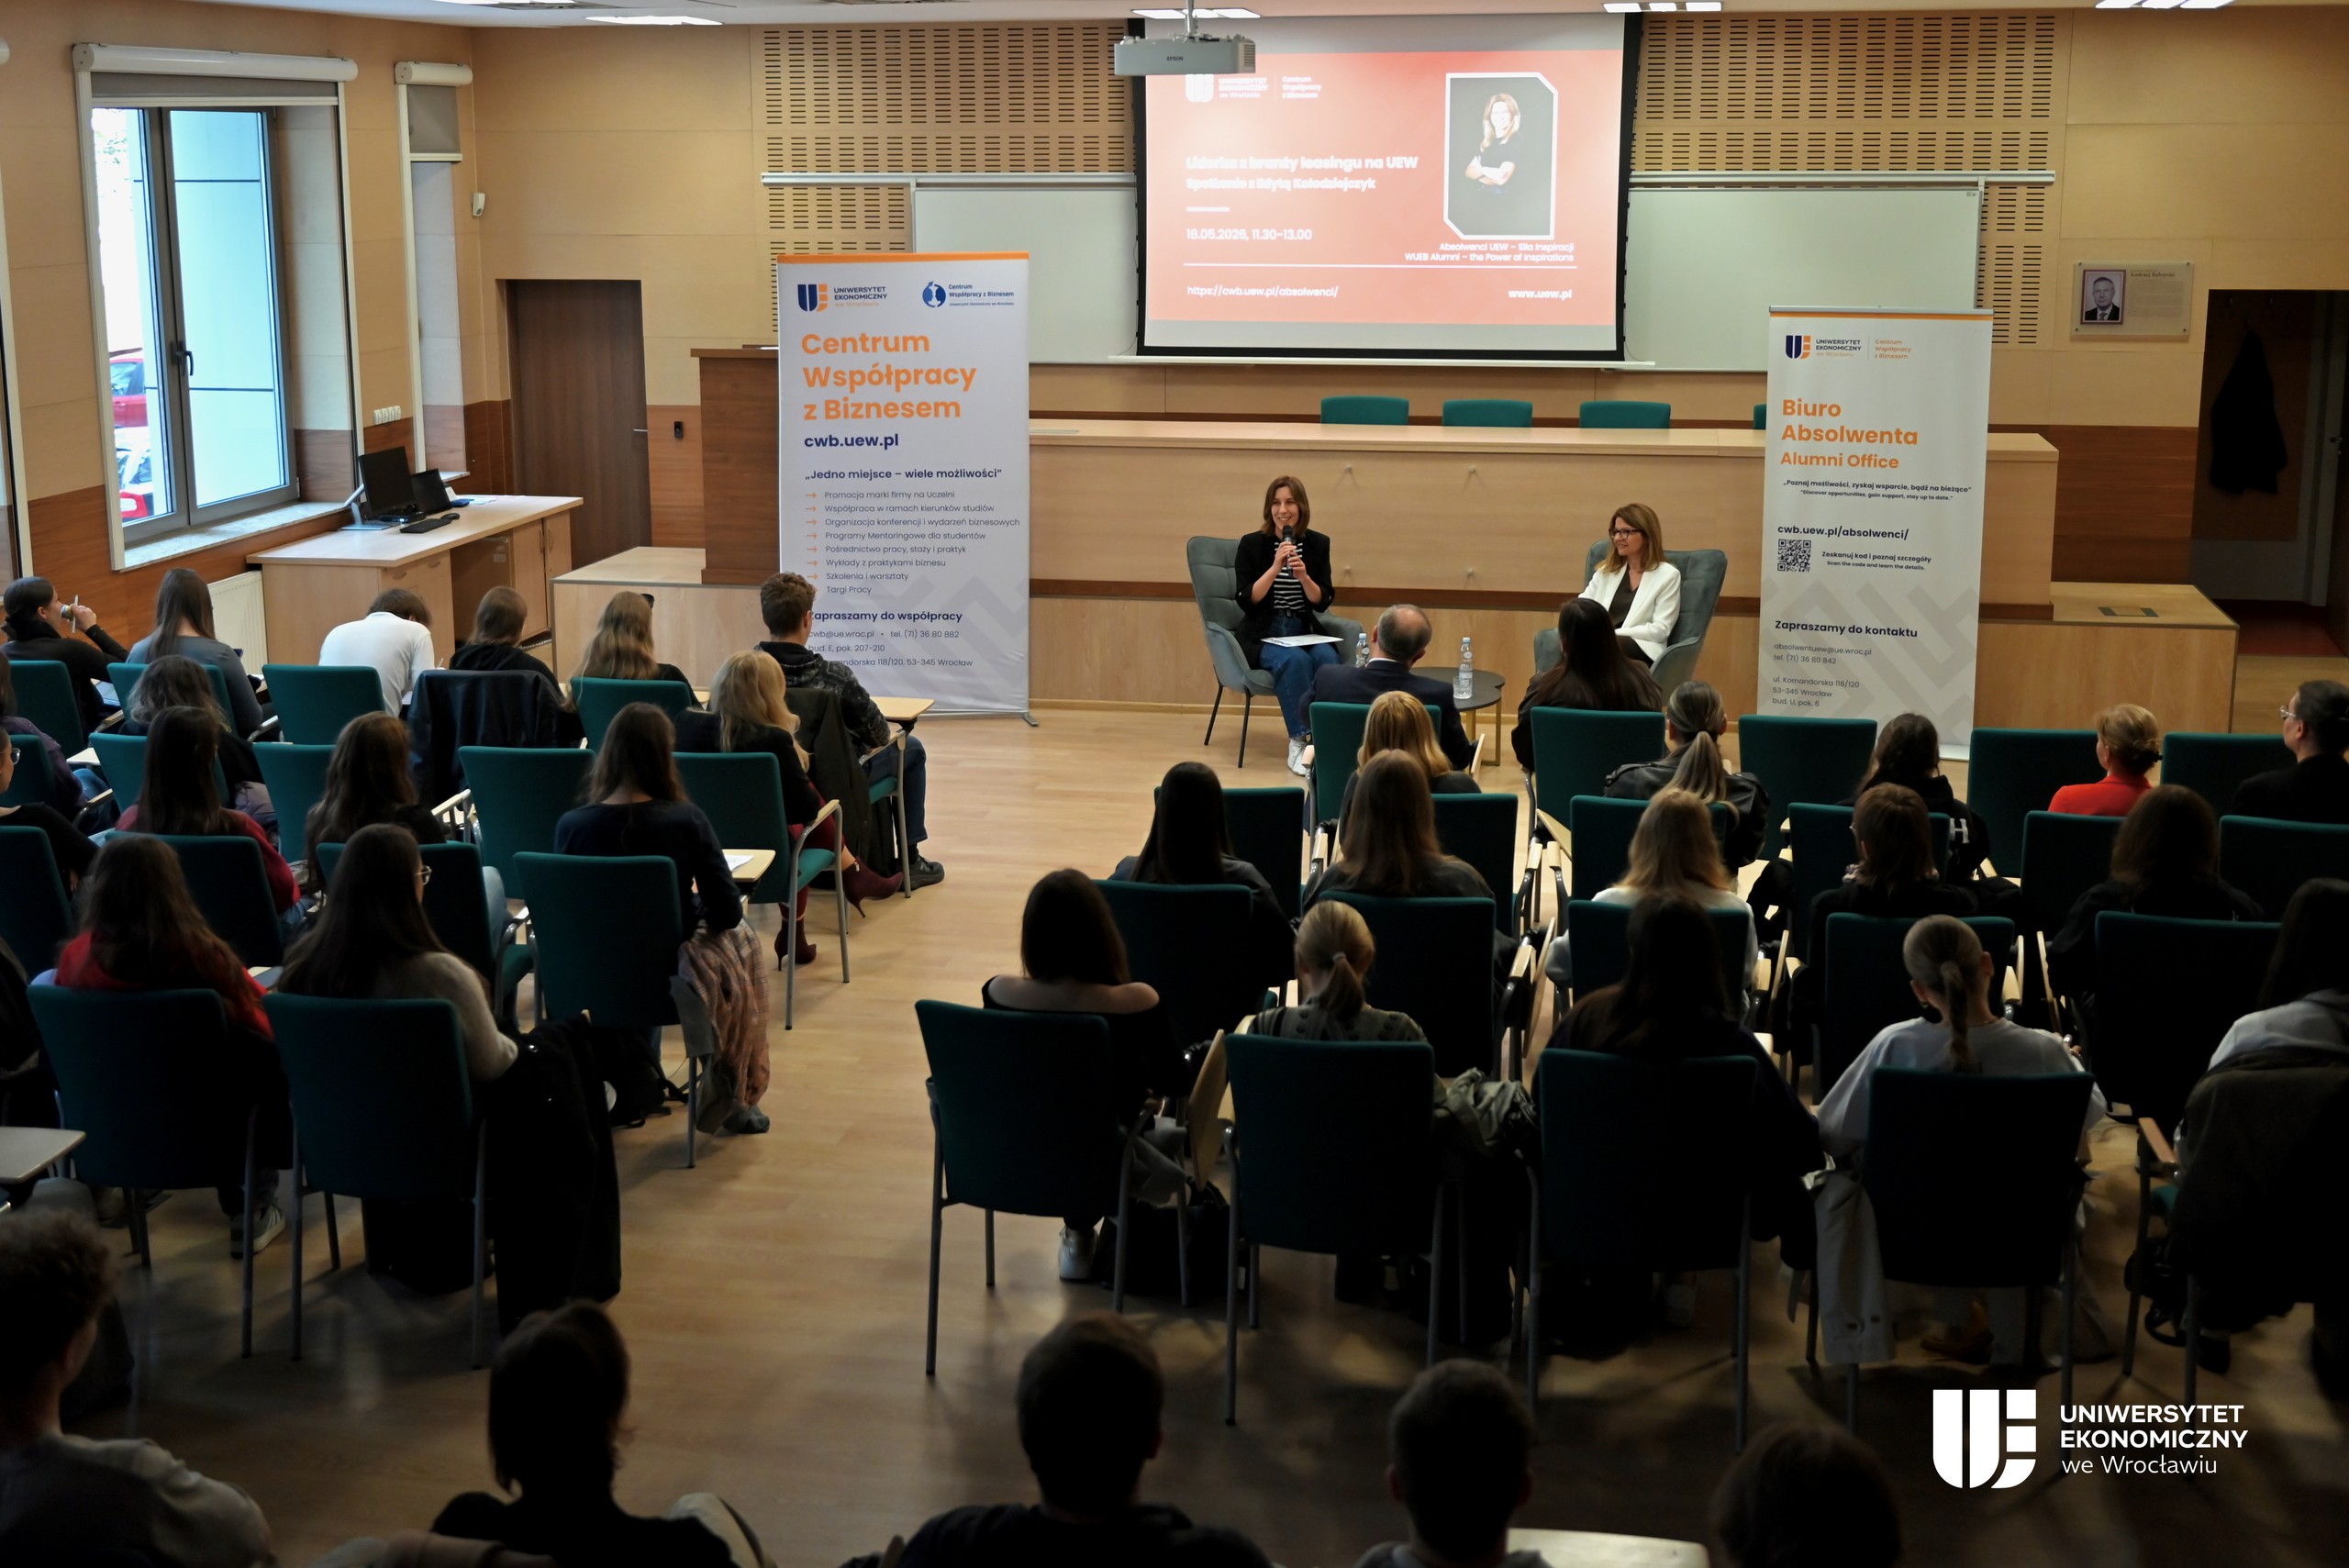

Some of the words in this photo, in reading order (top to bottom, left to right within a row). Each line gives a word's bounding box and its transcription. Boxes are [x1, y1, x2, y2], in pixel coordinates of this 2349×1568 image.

[801, 333, 930, 354] Centrum
[803, 362, 976, 394] Współpracy
[804, 404, 817, 420] z
[824, 396, 961, 420] Biznesem
[1782, 398, 1842, 417] Biuro
[1781, 424, 1918, 445] Absolwenta
[804, 433, 898, 450] cwb.uew.pl
[1780, 451, 1843, 467] Alumni
[1847, 453, 1899, 469] Office
[848, 469, 892, 481] miejsce
[905, 468, 934, 478] wiele
[824, 491, 864, 500] Promocja
[891, 491, 912, 500] firmy
[926, 490, 955, 498] Uczelni
[824, 505, 875, 514] Współpraca
[825, 518, 875, 528] Organizacja
[876, 517, 922, 528] konferencji
[927, 517, 967, 527] wydarzeń
[968, 518, 1020, 528] biznesowych
[825, 532, 866, 541] Programy
[867, 532, 926, 541] Mentoringowe
[1777, 525, 1909, 540] cwb.uew.pl/absolwenci/
[825, 545, 881, 553] Pośrednictwo
[909, 546, 930, 554] staży
[937, 545, 966, 554] praktyk
[1821, 550, 1854, 560] Zeskanuj
[1872, 554, 1896, 562] poznaj
[1897, 556, 1932, 564] szczegóły
[826, 559, 861, 568] Wykłady
[868, 559, 914, 568] praktykami
[915, 559, 946, 567] biznesu
[869, 573, 908, 582] warsztaty
[827, 585, 847, 595] Targi
[849, 585, 872, 595] Pracy
[811, 612, 878, 622] apraszamy
[880, 611, 896, 620] do
[897, 611, 963, 623] współpracy
[808, 630, 874, 639] cwb@ue.wroc.pl
[904, 628, 918, 639] (71)
[931, 630, 942, 639] 80
[944, 630, 960, 639] 882
[1775, 620, 1846, 635] Zapraszamy
[1848, 625, 1863, 634] do
[1865, 626, 1918, 638] kontaktu
[828, 644, 834, 652] E,
[836, 644, 852, 653] pok.
[1786, 654, 1798, 662] (71)
[1783, 677, 1833, 686] Komandorska
[1835, 680, 1860, 688] 118/120
[1800, 689, 1832, 697] Wrocław
